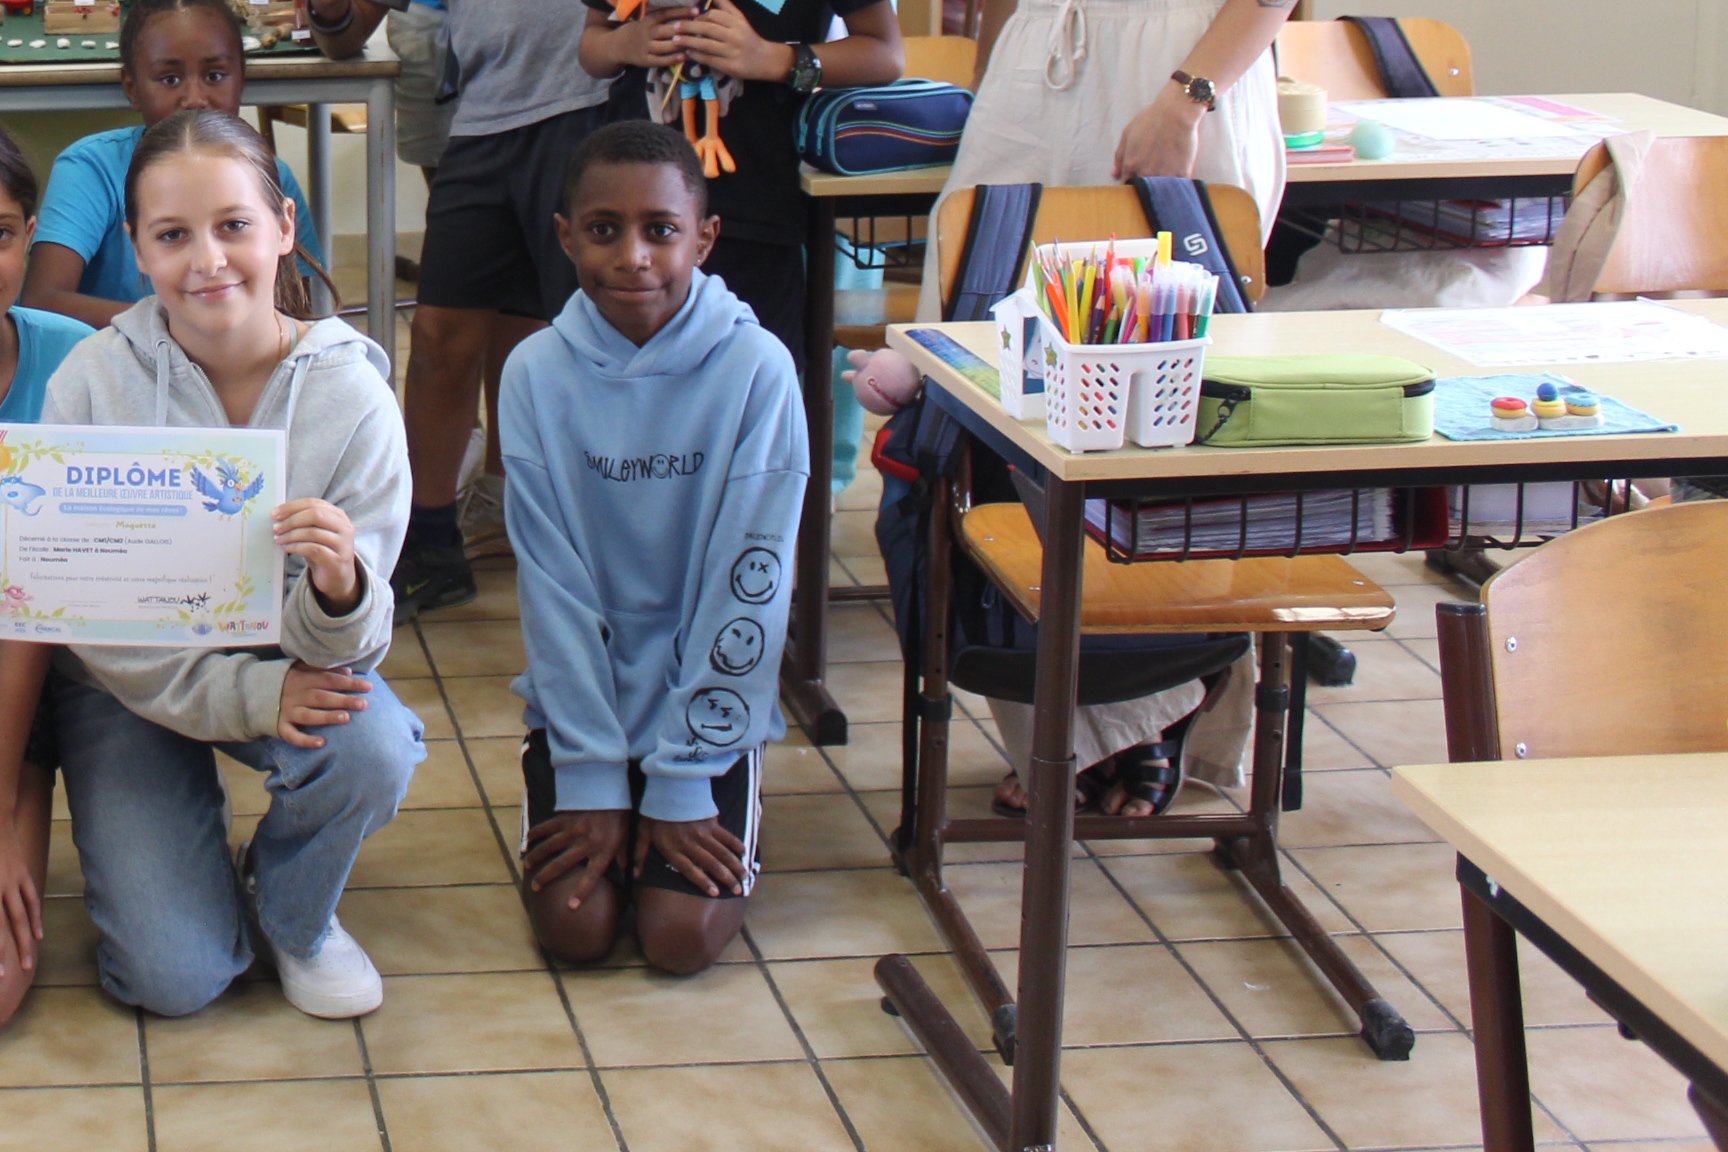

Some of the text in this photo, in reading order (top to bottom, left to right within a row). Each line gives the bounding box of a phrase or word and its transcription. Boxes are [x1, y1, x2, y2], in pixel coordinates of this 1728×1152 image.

[66, 461, 182, 487] DIPLÔME
[53, 487, 63, 497] DE
[64, 488, 76, 498] LA
[76, 488, 118, 499] MEILLEURE
[149, 490, 193, 501] ARTISTIQUE
[115, 521, 156, 530] Maquette
[19, 535, 45, 543] Décerné
